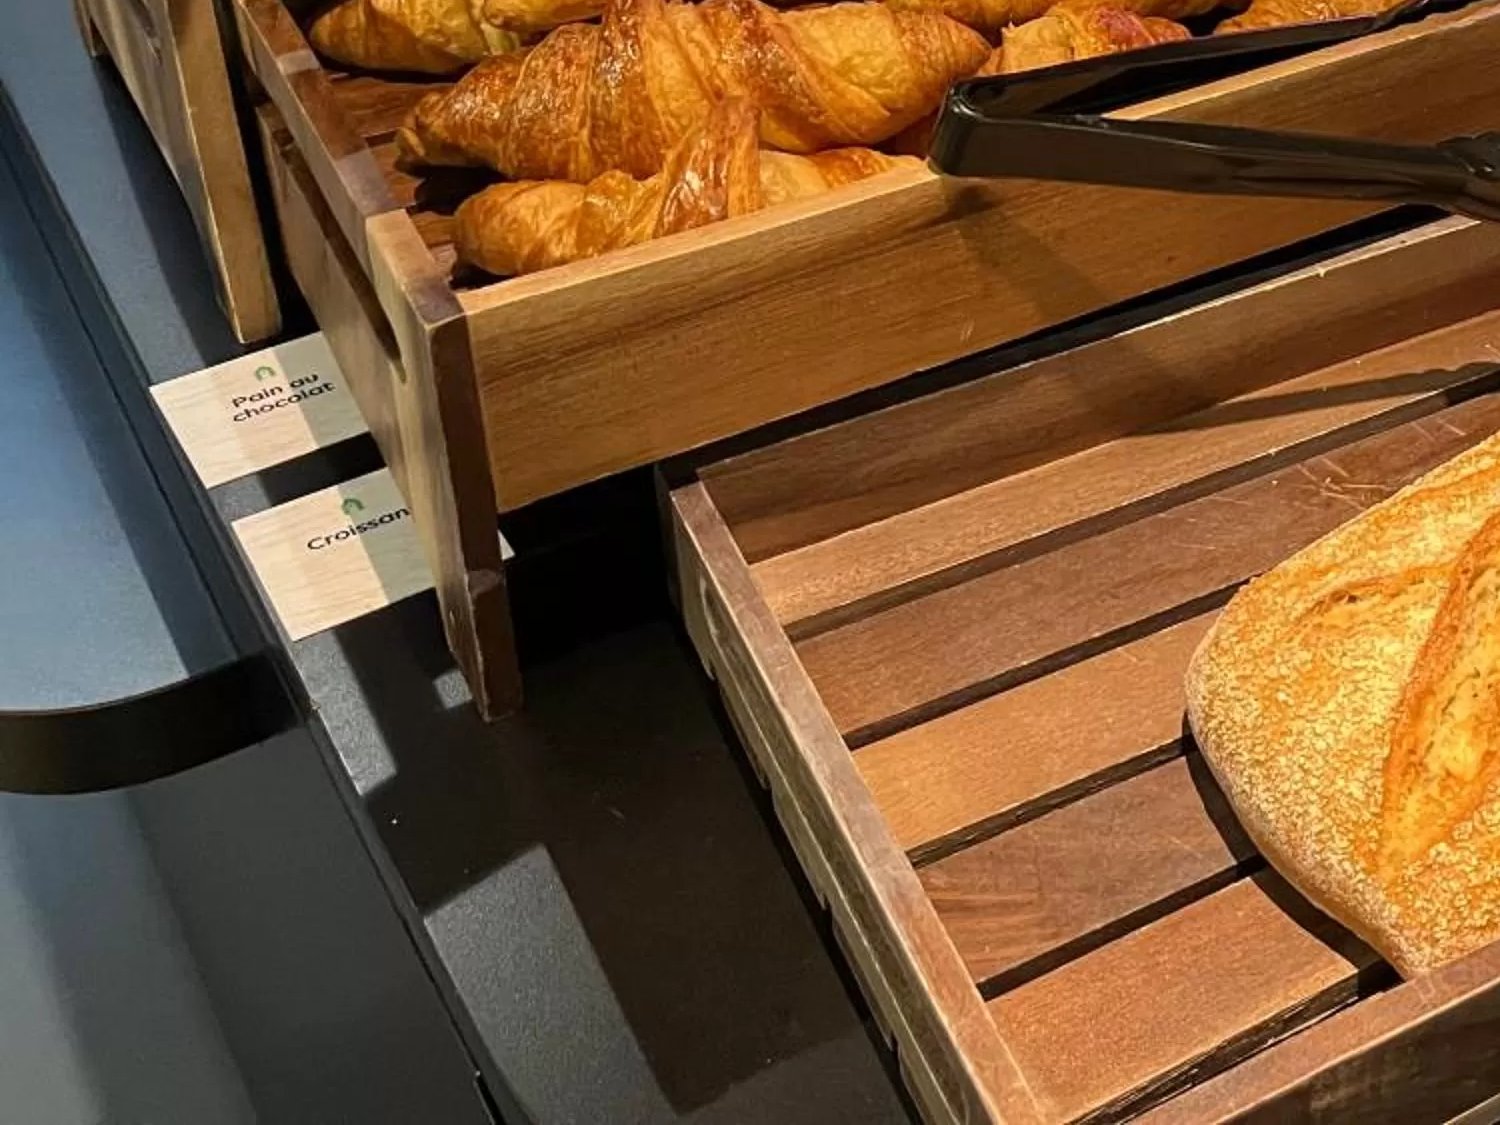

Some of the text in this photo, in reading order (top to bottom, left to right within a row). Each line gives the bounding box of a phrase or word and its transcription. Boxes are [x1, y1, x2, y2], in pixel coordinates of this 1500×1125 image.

[232, 373, 319, 408] Pain au
[233, 381, 337, 422] chocolat
[307, 507, 412, 550] Croissan
